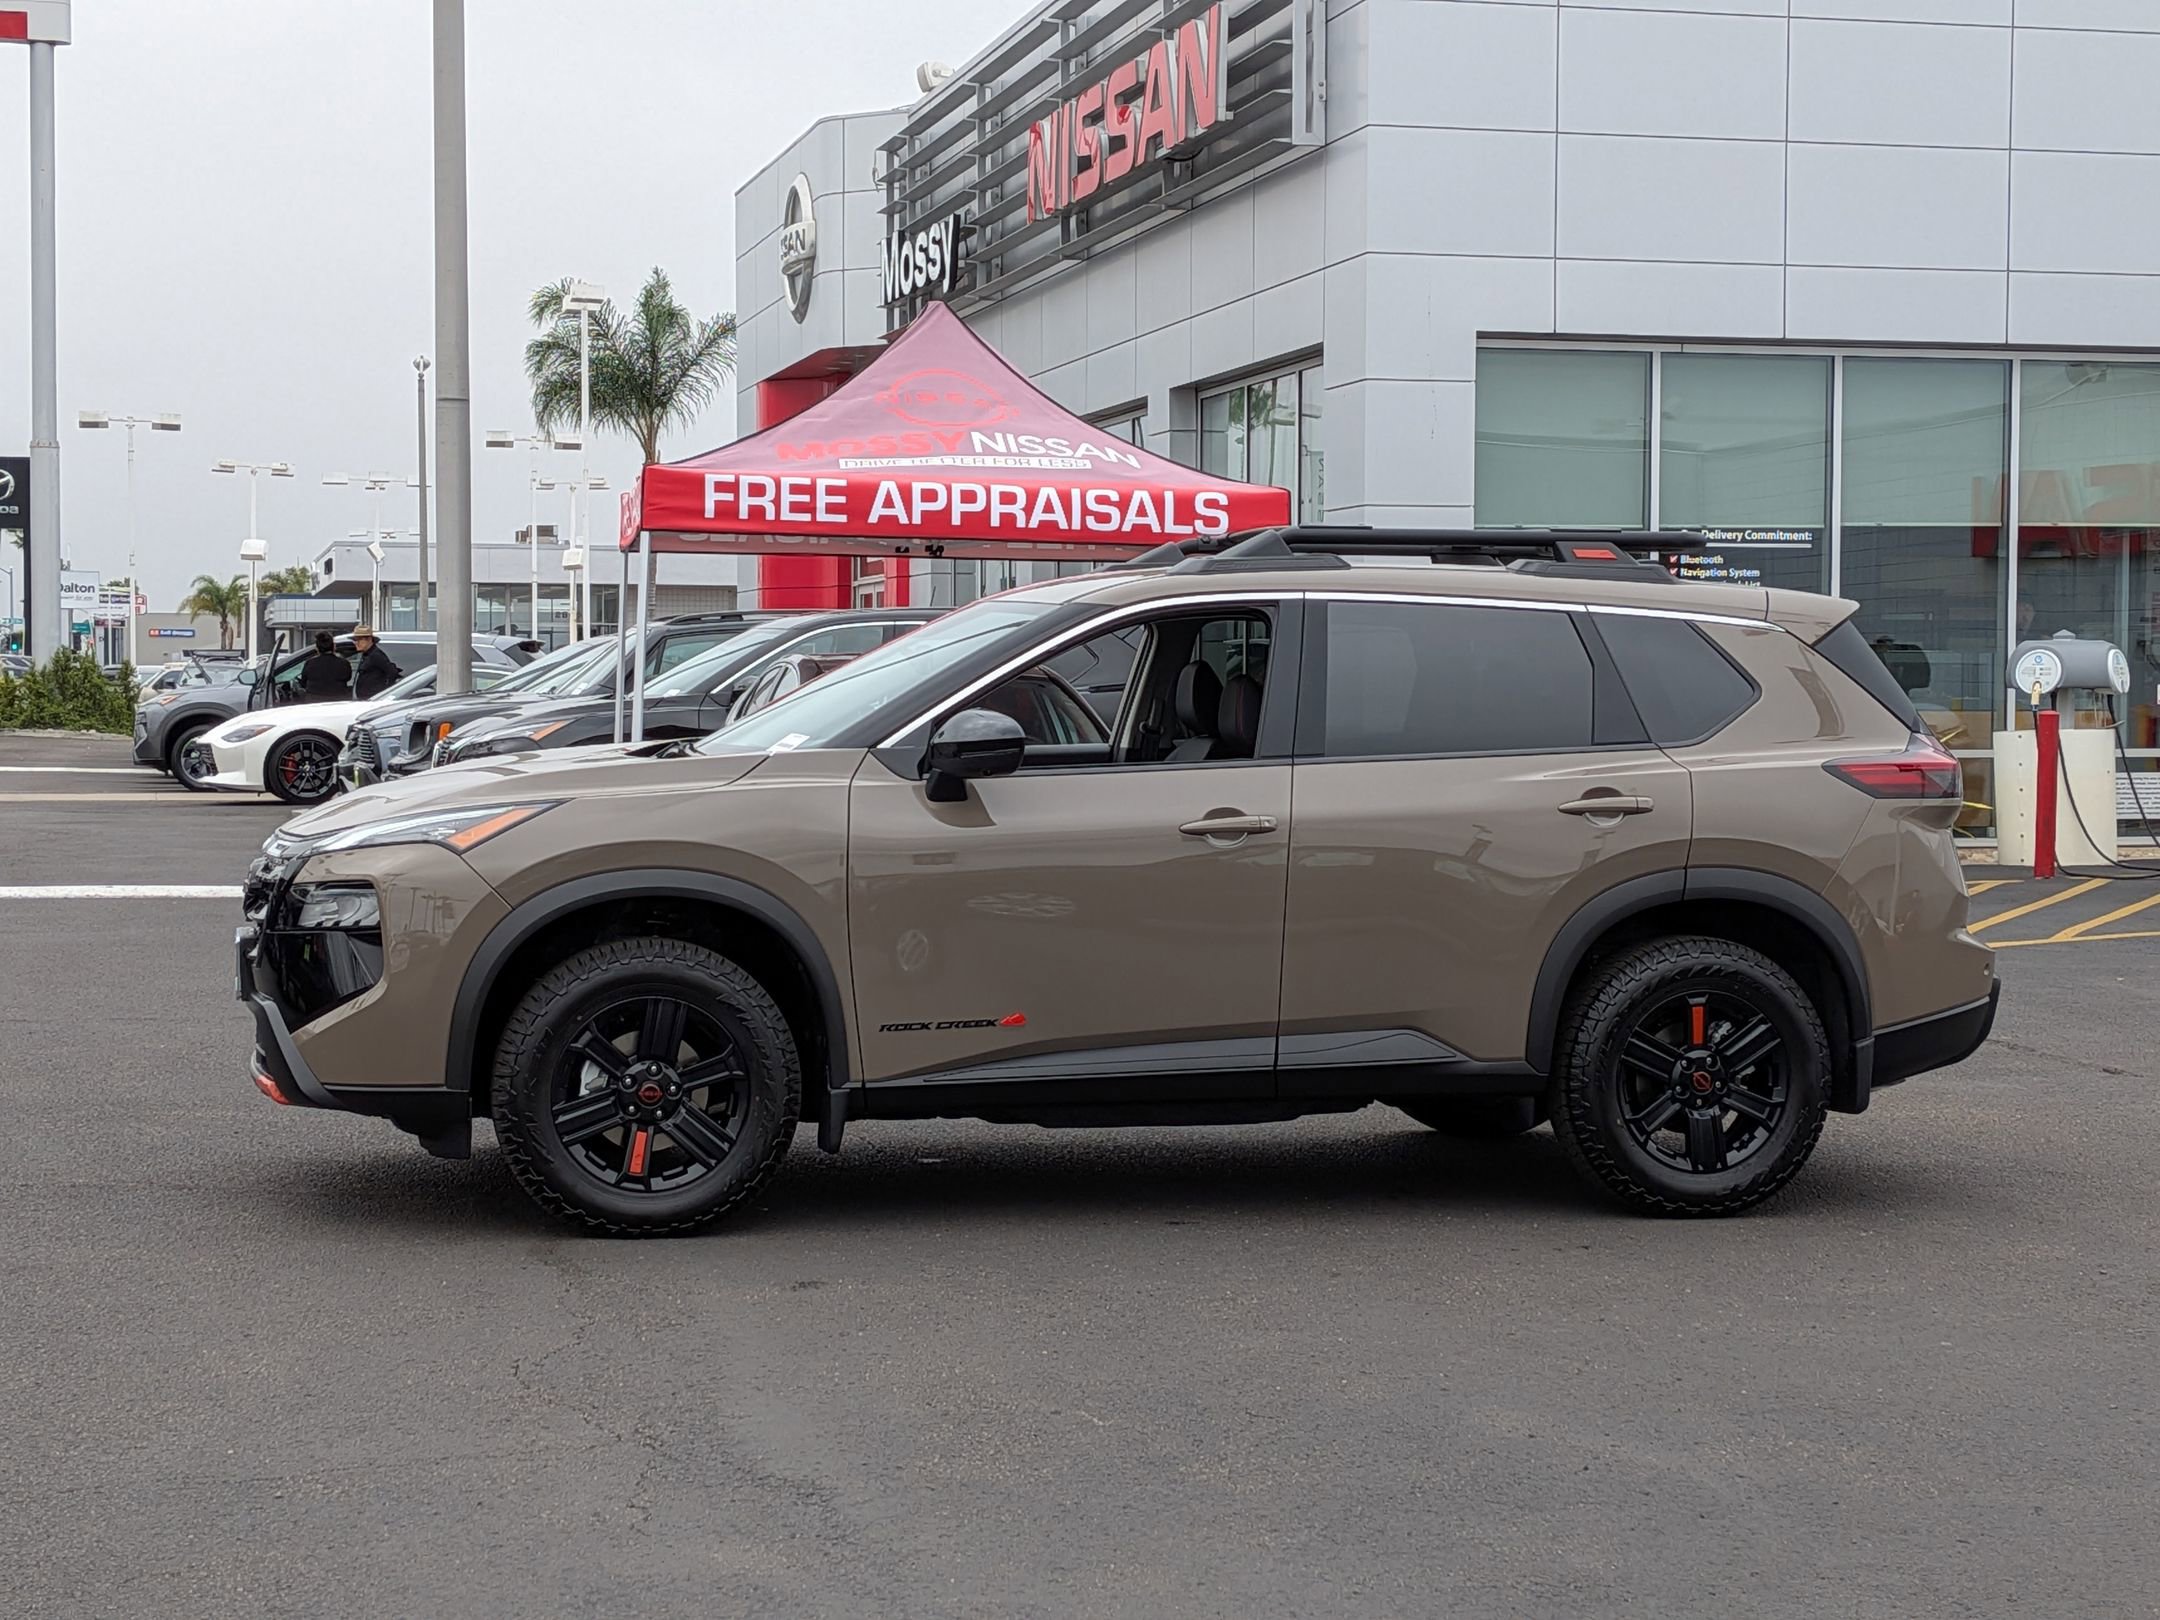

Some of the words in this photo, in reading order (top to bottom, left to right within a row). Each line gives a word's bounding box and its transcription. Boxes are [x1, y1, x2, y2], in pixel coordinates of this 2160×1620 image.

[1027, 2, 1220, 225] NISSAN
[880, 213, 954, 305] Mossy
[776, 431, 965, 460] MOSSY
[970, 431, 1141, 469] NISSAN
[704, 473, 848, 523] FREE
[867, 480, 1229, 535] APPRAISALS
[1701, 529, 1743, 541] Delivery
[1744, 529, 1812, 541] Commitment:
[1680, 555, 1724, 564] Bluetooth
[1680, 568, 1728, 579] Navigation
[1729, 568, 1760, 579] System
[878, 1021, 934, 1032] ROCK
[935, 1018, 999, 1030] CREEK
